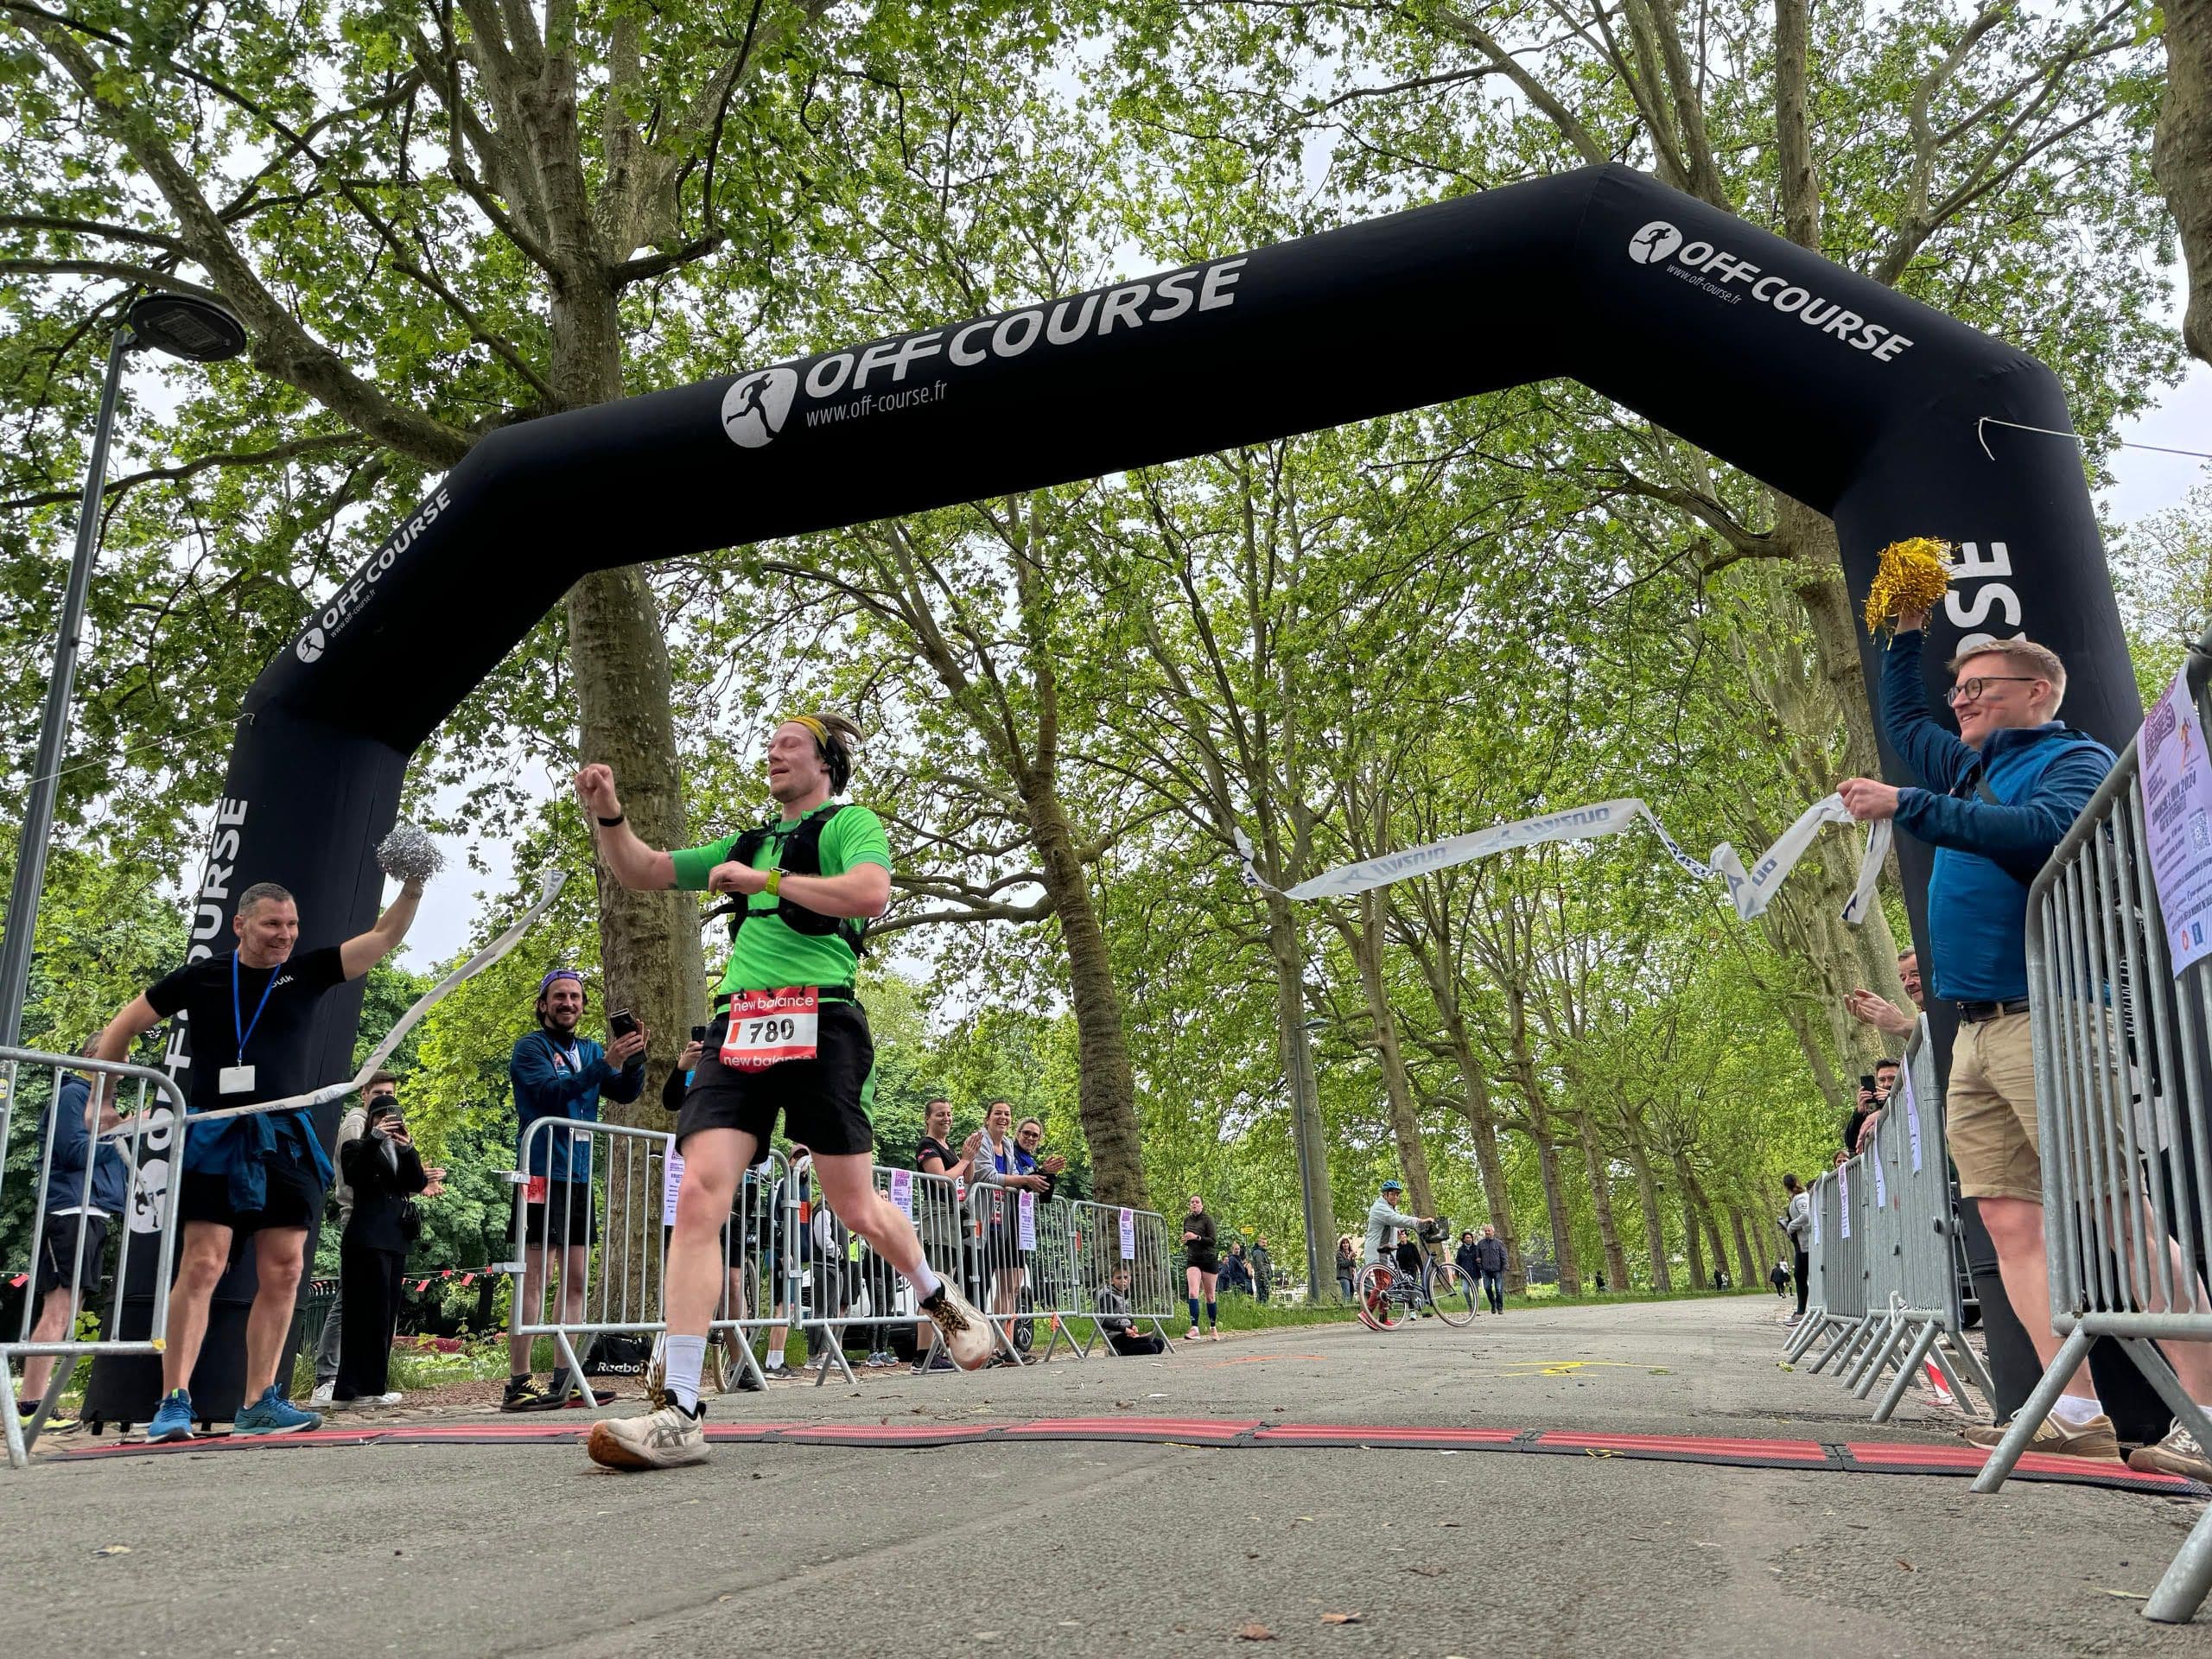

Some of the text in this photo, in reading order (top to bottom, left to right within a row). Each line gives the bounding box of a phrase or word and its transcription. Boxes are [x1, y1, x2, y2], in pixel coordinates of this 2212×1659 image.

[1667, 264, 1741, 304] www.off-course.fr
[1679, 241, 1914, 362] OFFCOURSE
[805, 257, 1249, 398] OFFCOURSE
[805, 379, 947, 427] www.off-course.fr
[322, 488, 451, 630] OFFCOURSE
[734, 996, 814, 1012] new balance
[749, 1018, 795, 1044] 780
[723, 1056, 751, 1066] new
